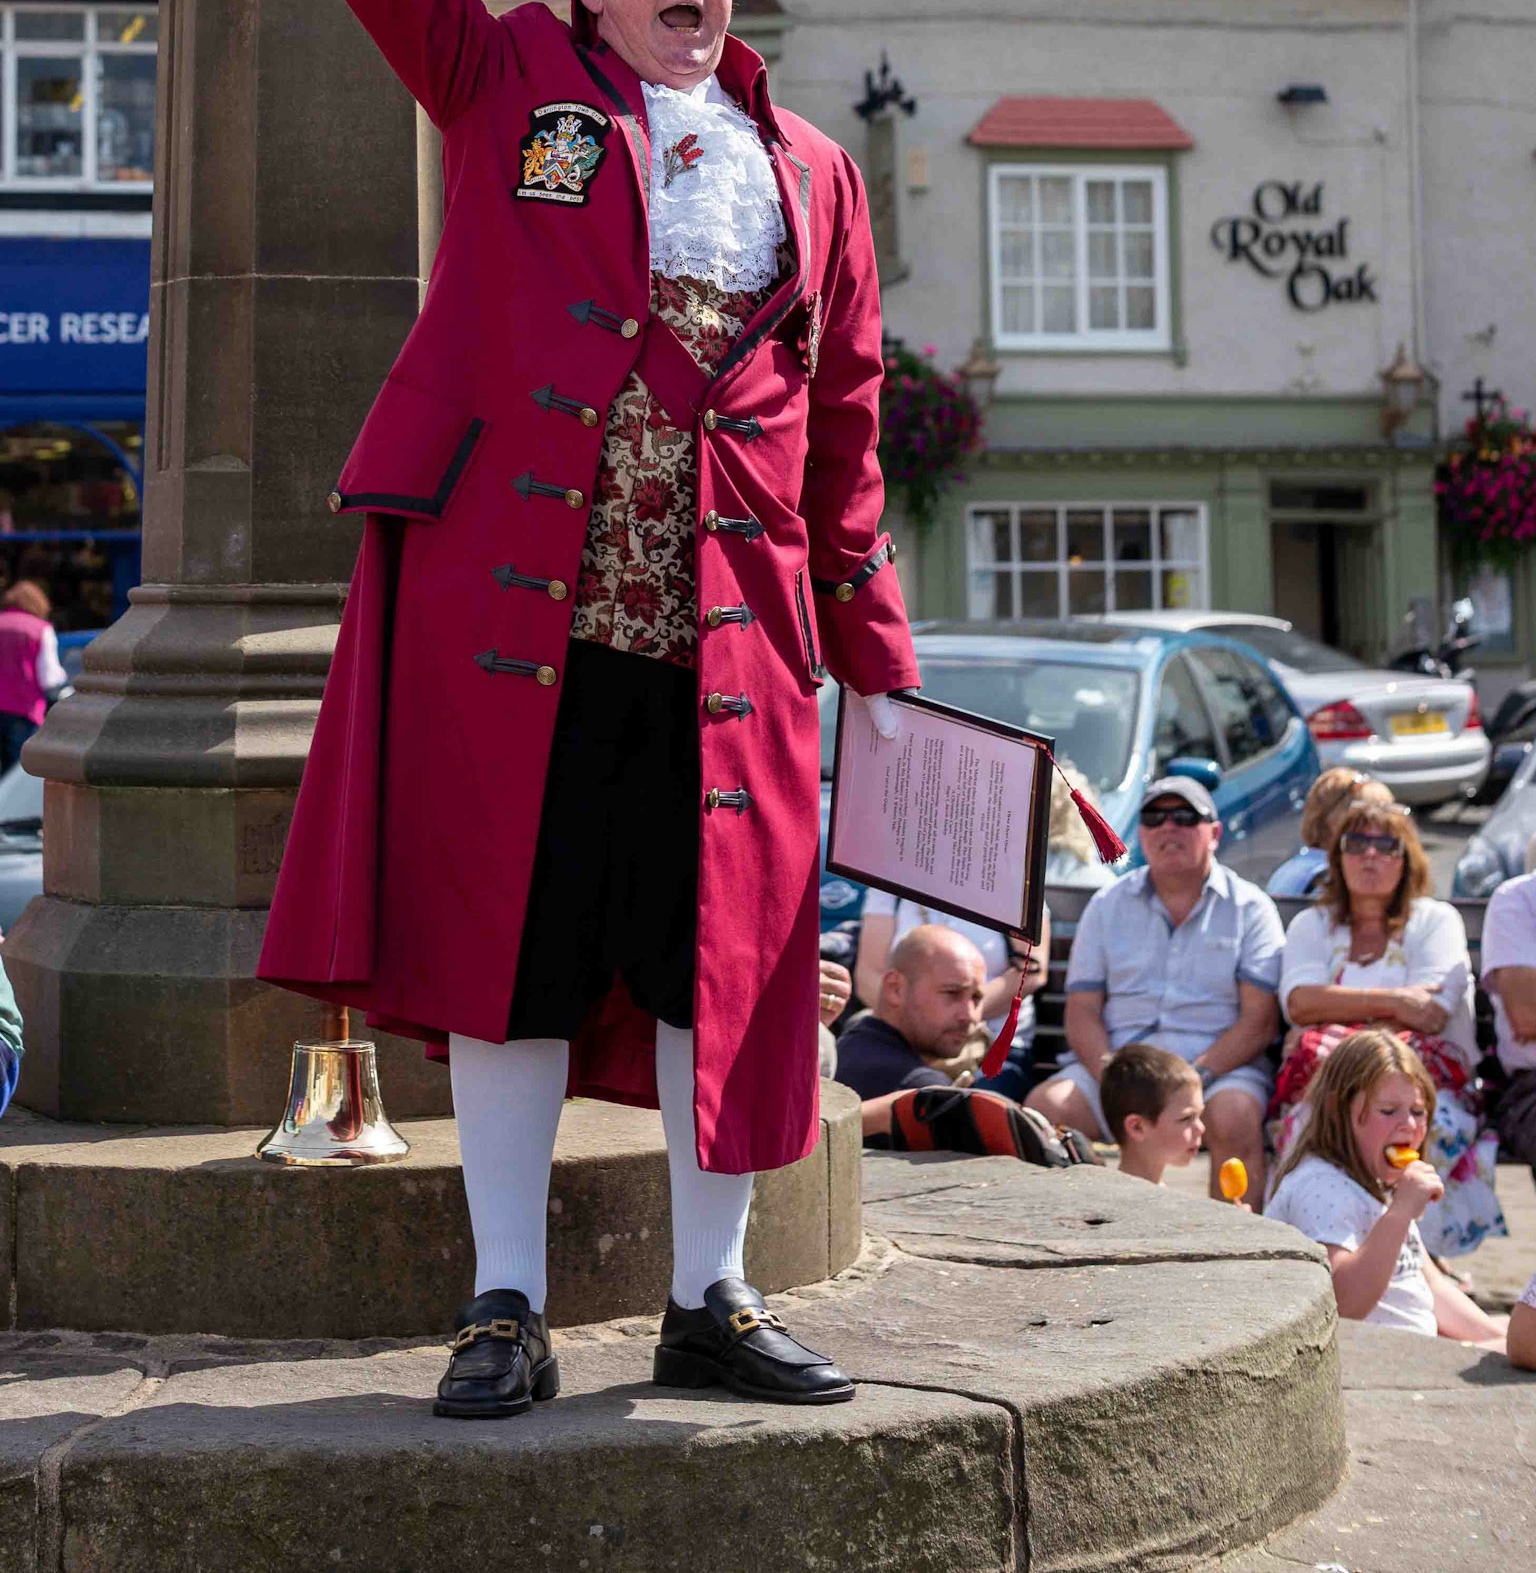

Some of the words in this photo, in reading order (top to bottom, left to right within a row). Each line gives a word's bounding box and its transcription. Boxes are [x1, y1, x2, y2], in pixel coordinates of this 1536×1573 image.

[538, 105, 572, 115] Darlington
[575, 105, 589, 113] Town
[592, 112, 604, 122] Crier
[1253, 179, 1326, 223] Old
[1210, 217, 1352, 280] Royal
[1287, 263, 1378, 314] Oak
